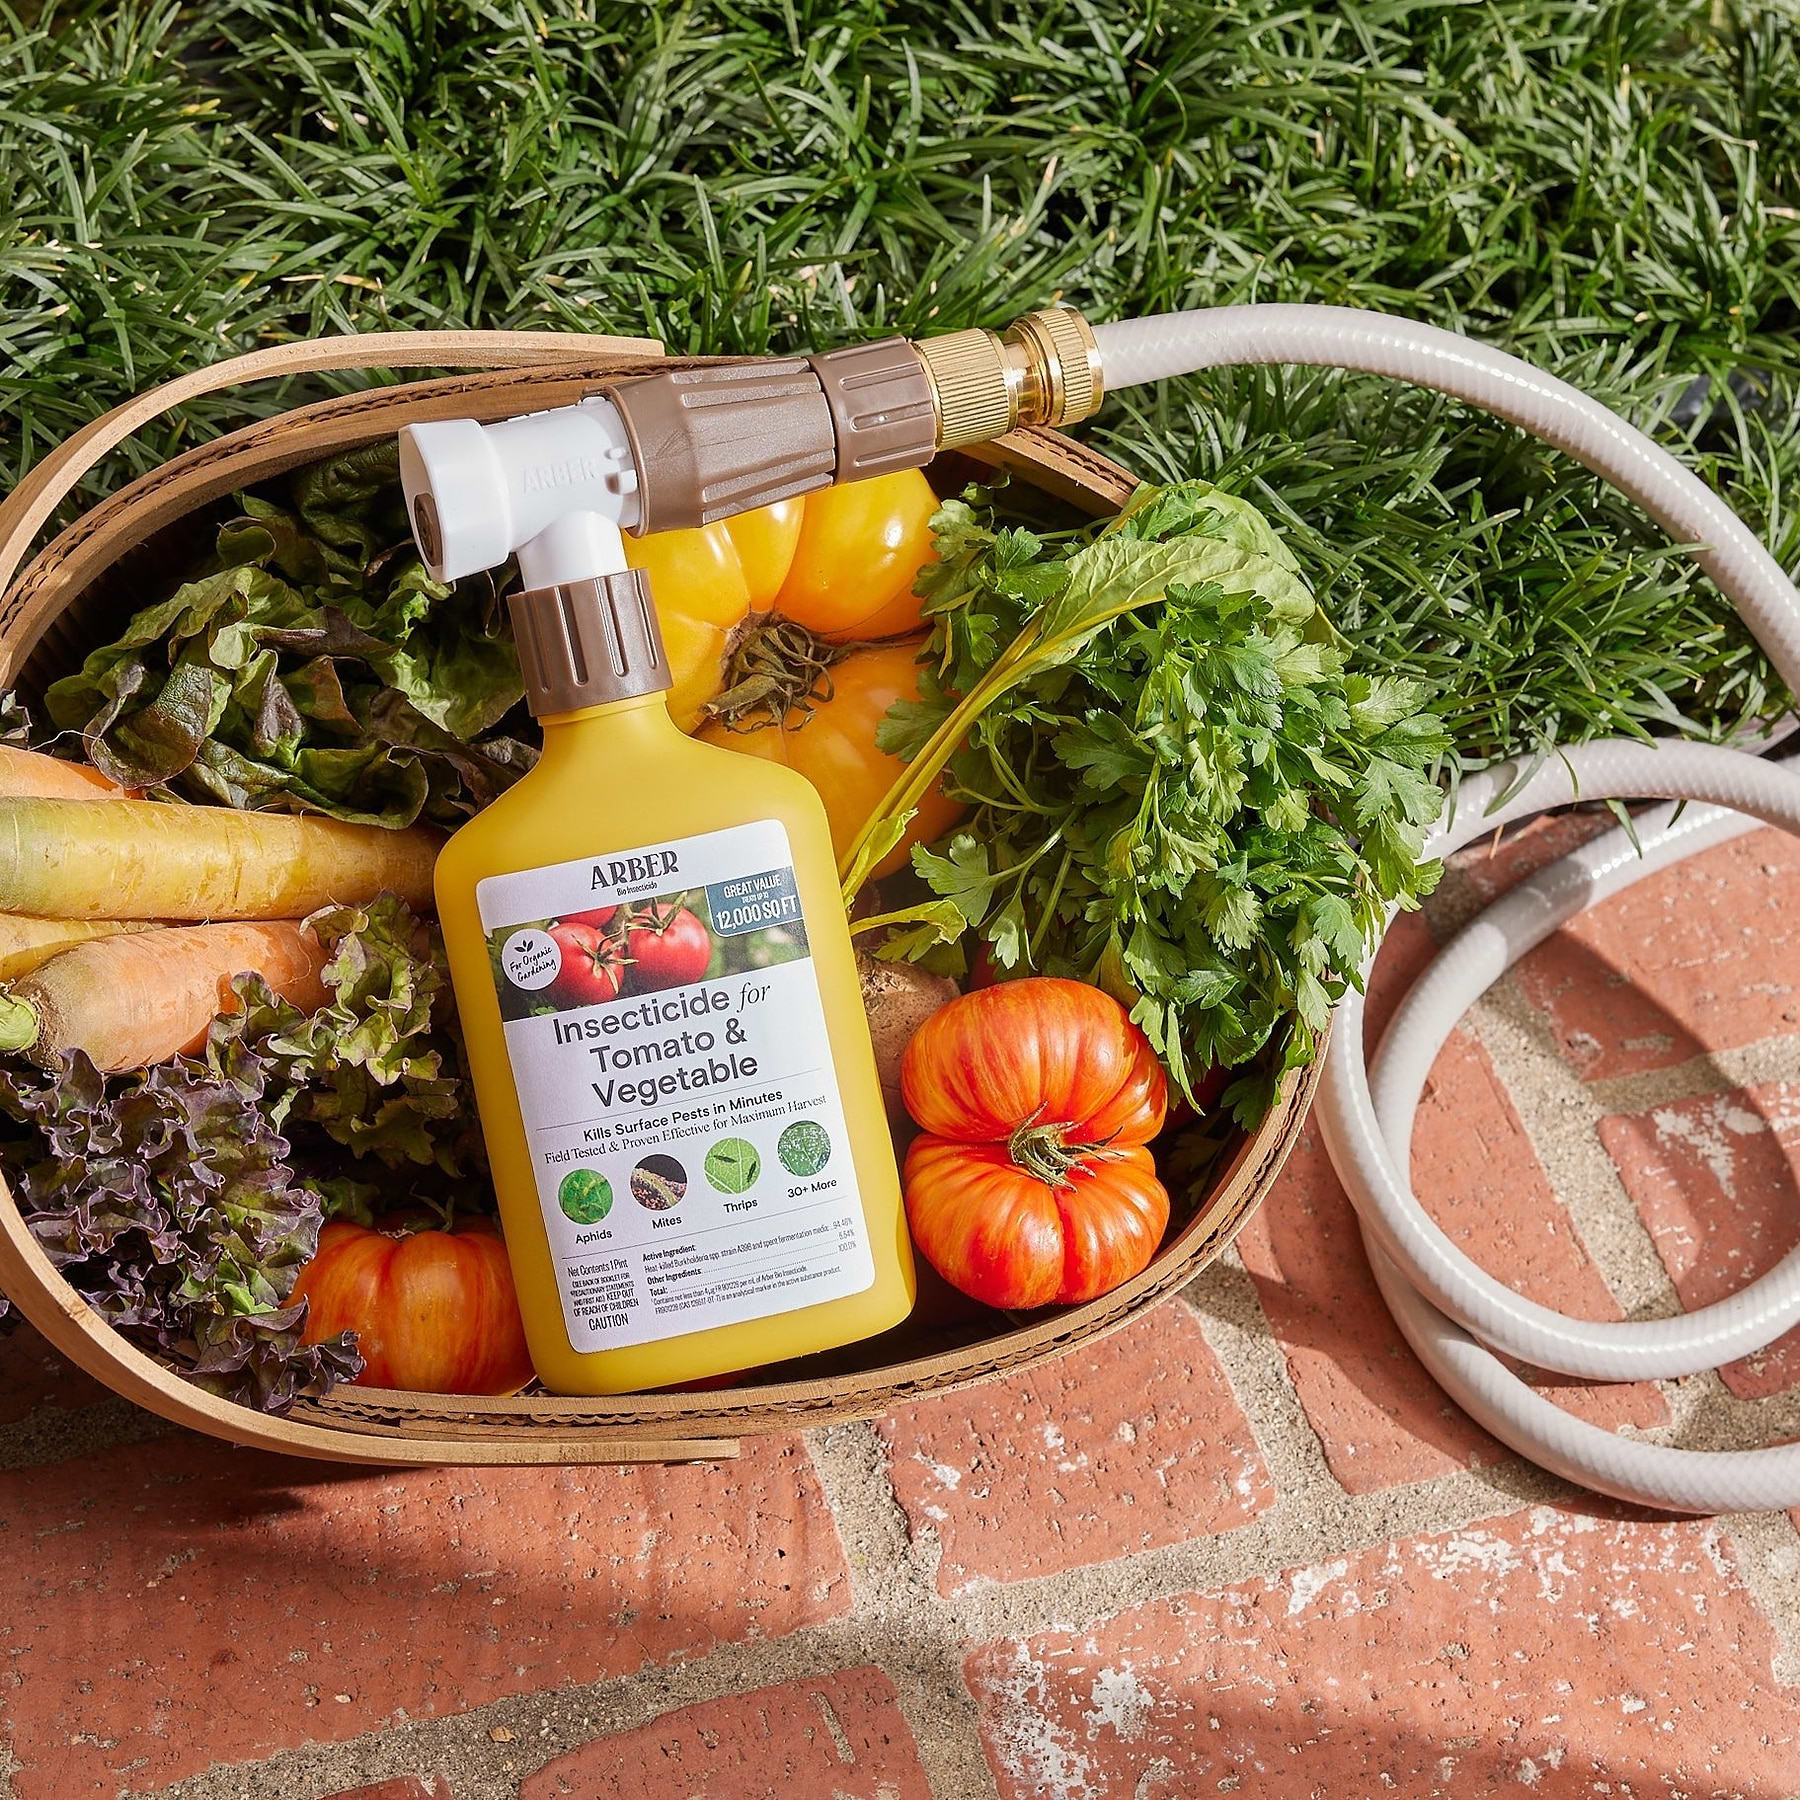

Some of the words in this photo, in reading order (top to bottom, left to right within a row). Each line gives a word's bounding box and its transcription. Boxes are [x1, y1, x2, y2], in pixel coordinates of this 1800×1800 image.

[523, 458, 598, 493] ARBER
[591, 850, 679, 890] ARBER
[616, 888, 626, 896] Bio
[626, 881, 657, 894] Insecticide
[724, 881, 752, 898] GREAT
[754, 874, 781, 892] VALUE
[716, 905, 761, 930] 12,000
[761, 899, 780, 919] SQ
[780, 894, 796, 915] FT
[509, 961, 522, 973] For
[522, 946, 552, 967] Organic
[517, 958, 557, 982] Gardening
[552, 987, 729, 1045] Insecticide
[736, 982, 770, 1013] for
[589, 1031, 714, 1073] Tomato
[725, 1017, 747, 1044] &
[591, 1053, 757, 1107] Vegetable
[583, 1127, 611, 1142] Kills
[614, 1117, 668, 1135] Surface
[671, 1107, 709, 1123] Pests
[712, 1103, 726, 1114] in
[729, 1091, 782, 1111] Minutes
[544, 1149, 570, 1164] Field
[570, 1143, 606, 1159] Tested
[608, 1141, 619, 1152] &
[621, 1135, 660, 1149] Proven
[662, 1123, 710, 1141] Effective
[713, 1118, 727, 1130] for
[730, 1106, 785, 1126] Maximum
[787, 1095, 826, 1112] Harvest
[787, 1186, 808, 1198] 30+
[810, 1179, 836, 1192] More
[723, 1199, 758, 1213] Thrips
[652, 1216, 682, 1229] Mites
[575, 1229, 612, 1244] Aphids
[720, 1248, 737, 1257] strain
[752, 1240, 763, 1250] and
[762, 1237, 778, 1248] spent
[778, 1230, 812, 1243] fermentation
[567, 1266, 580, 1277] Net
[579, 1263, 610, 1275] Contents
[613, 1258, 628, 1269] Pint
[643, 1252, 662, 1262] Active
[646, 1276, 664, 1285] Other
[649, 1286, 668, 1296] Total:
[605, 1290, 621, 1301] KEEP
[621, 1288, 633, 1298] OUT
[573, 1307, 580, 1317] OF
[581, 1305, 601, 1315] REACH
[600, 1303, 608, 1312] OF
[609, 1298, 639, 1311] CHILDREN
[588, 1312, 629, 1331] CAUTION
